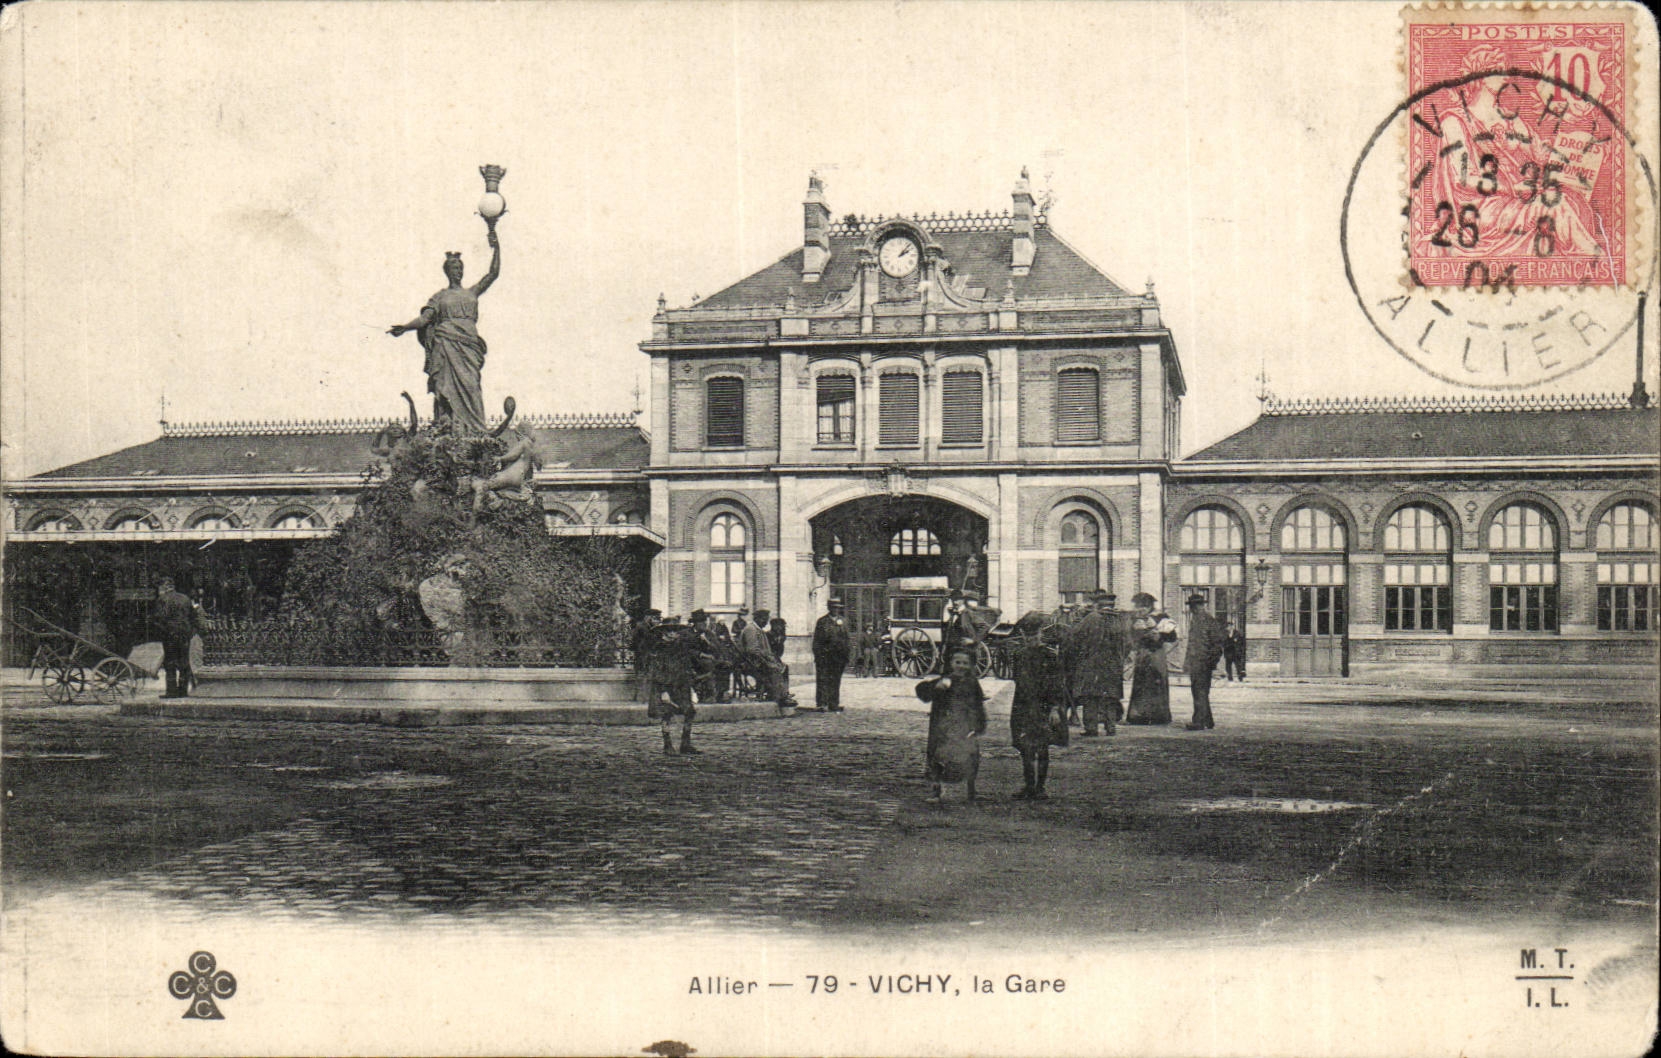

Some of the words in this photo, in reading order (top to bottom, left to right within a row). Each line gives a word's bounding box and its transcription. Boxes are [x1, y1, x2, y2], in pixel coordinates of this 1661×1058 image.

[1468, 25, 1568, 40] POSTES
[1547, 52, 1591, 103] 10
[1412, 82, 1612, 155] VICHY
[1568, 151, 1584, 164] DE
[1417, 261, 1523, 280] REPVLQVE
[1527, 260, 1621, 281] FRANÇAISE
[1377, 294, 1608, 378] ALLIER
